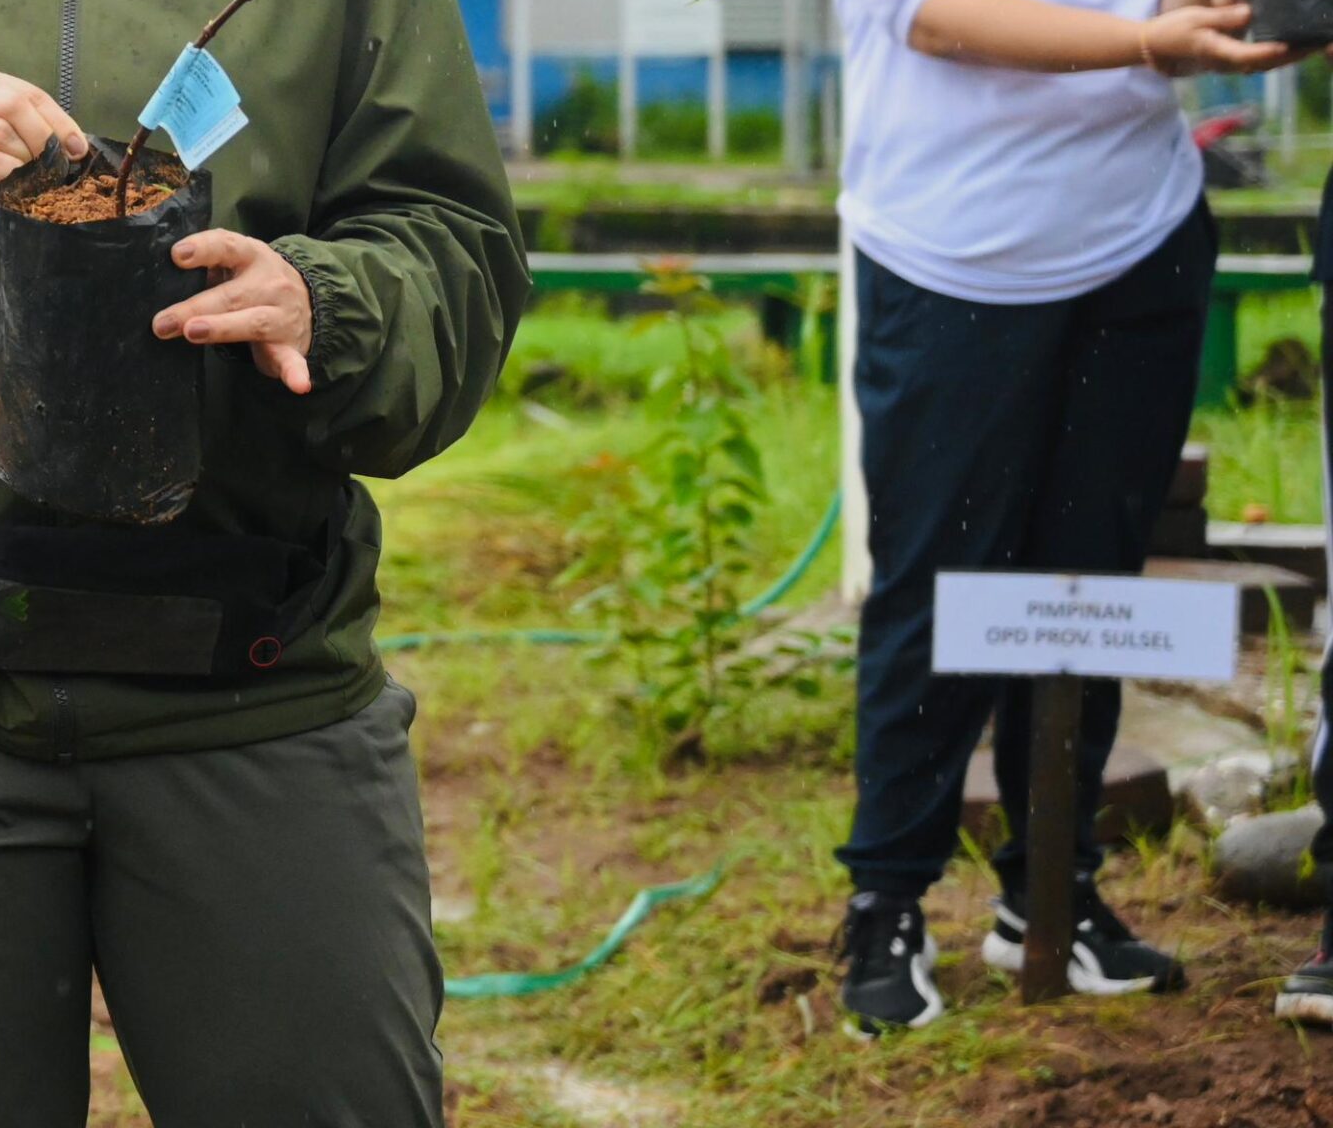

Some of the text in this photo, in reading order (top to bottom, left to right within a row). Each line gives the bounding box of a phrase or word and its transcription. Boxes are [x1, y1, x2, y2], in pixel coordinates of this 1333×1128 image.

[1026, 600, 1133, 621] PIMPINAN
[1034, 626, 1092, 648] PROV.
[1099, 630, 1174, 651] SULSEL
